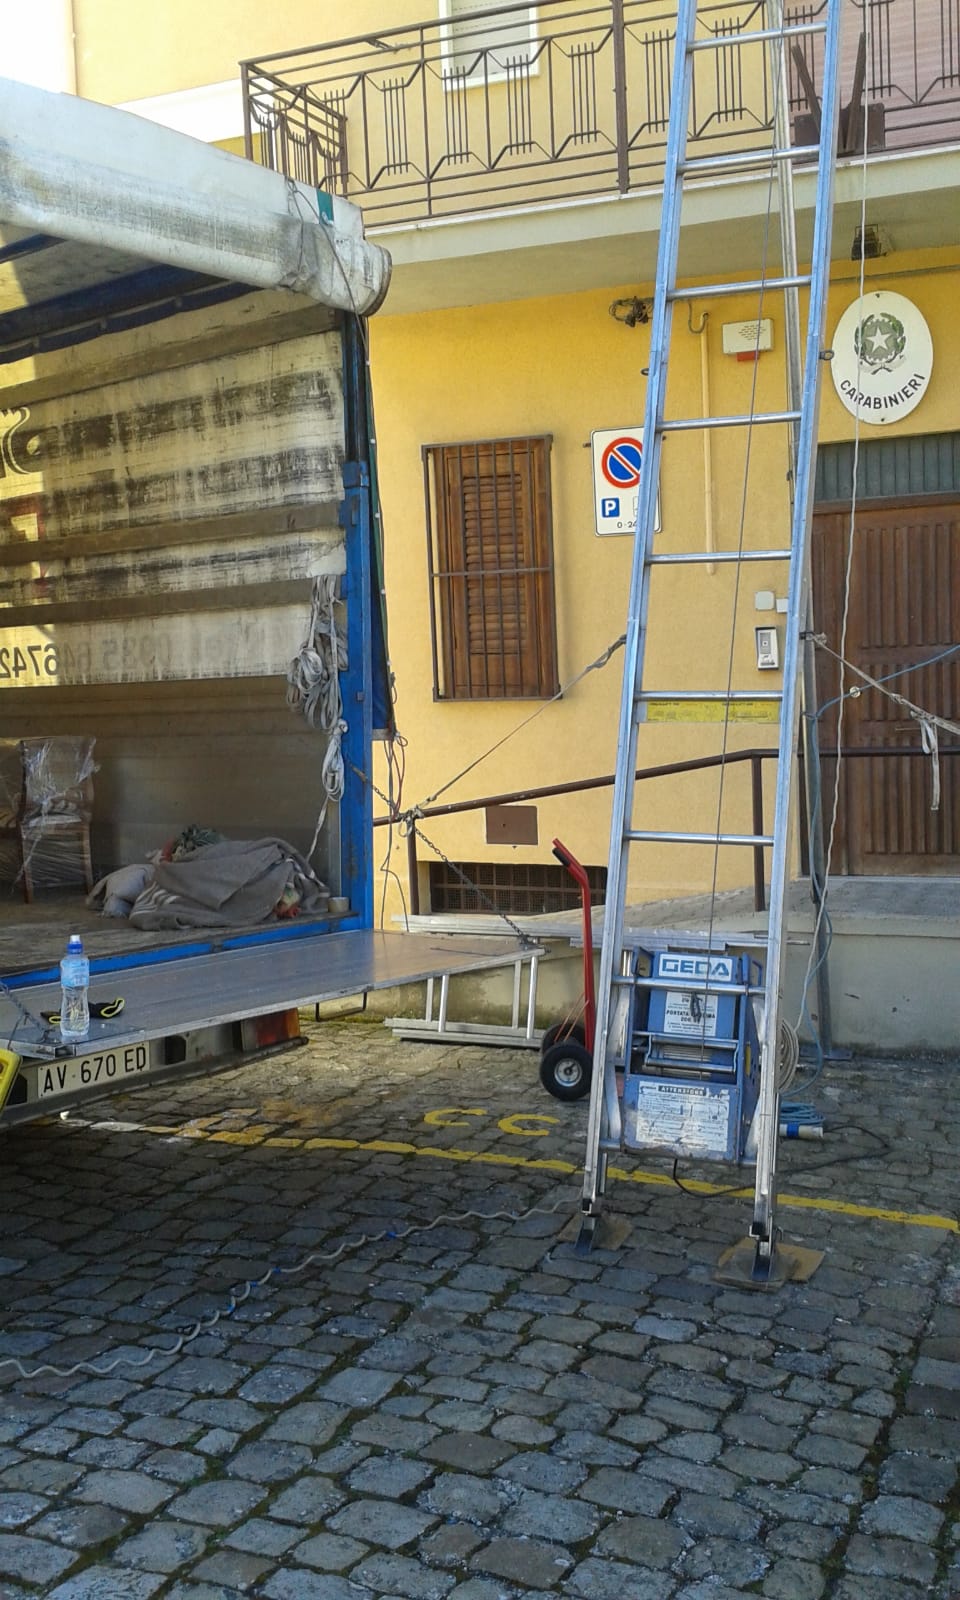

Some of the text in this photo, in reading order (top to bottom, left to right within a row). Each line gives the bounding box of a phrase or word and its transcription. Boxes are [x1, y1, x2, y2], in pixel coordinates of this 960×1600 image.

[840, 373, 925, 409] CARABINIERI
[605, 500, 616, 516] P
[662, 959, 729, 977] GEDA
[43, 1046, 146, 1093] AV 670 ED
